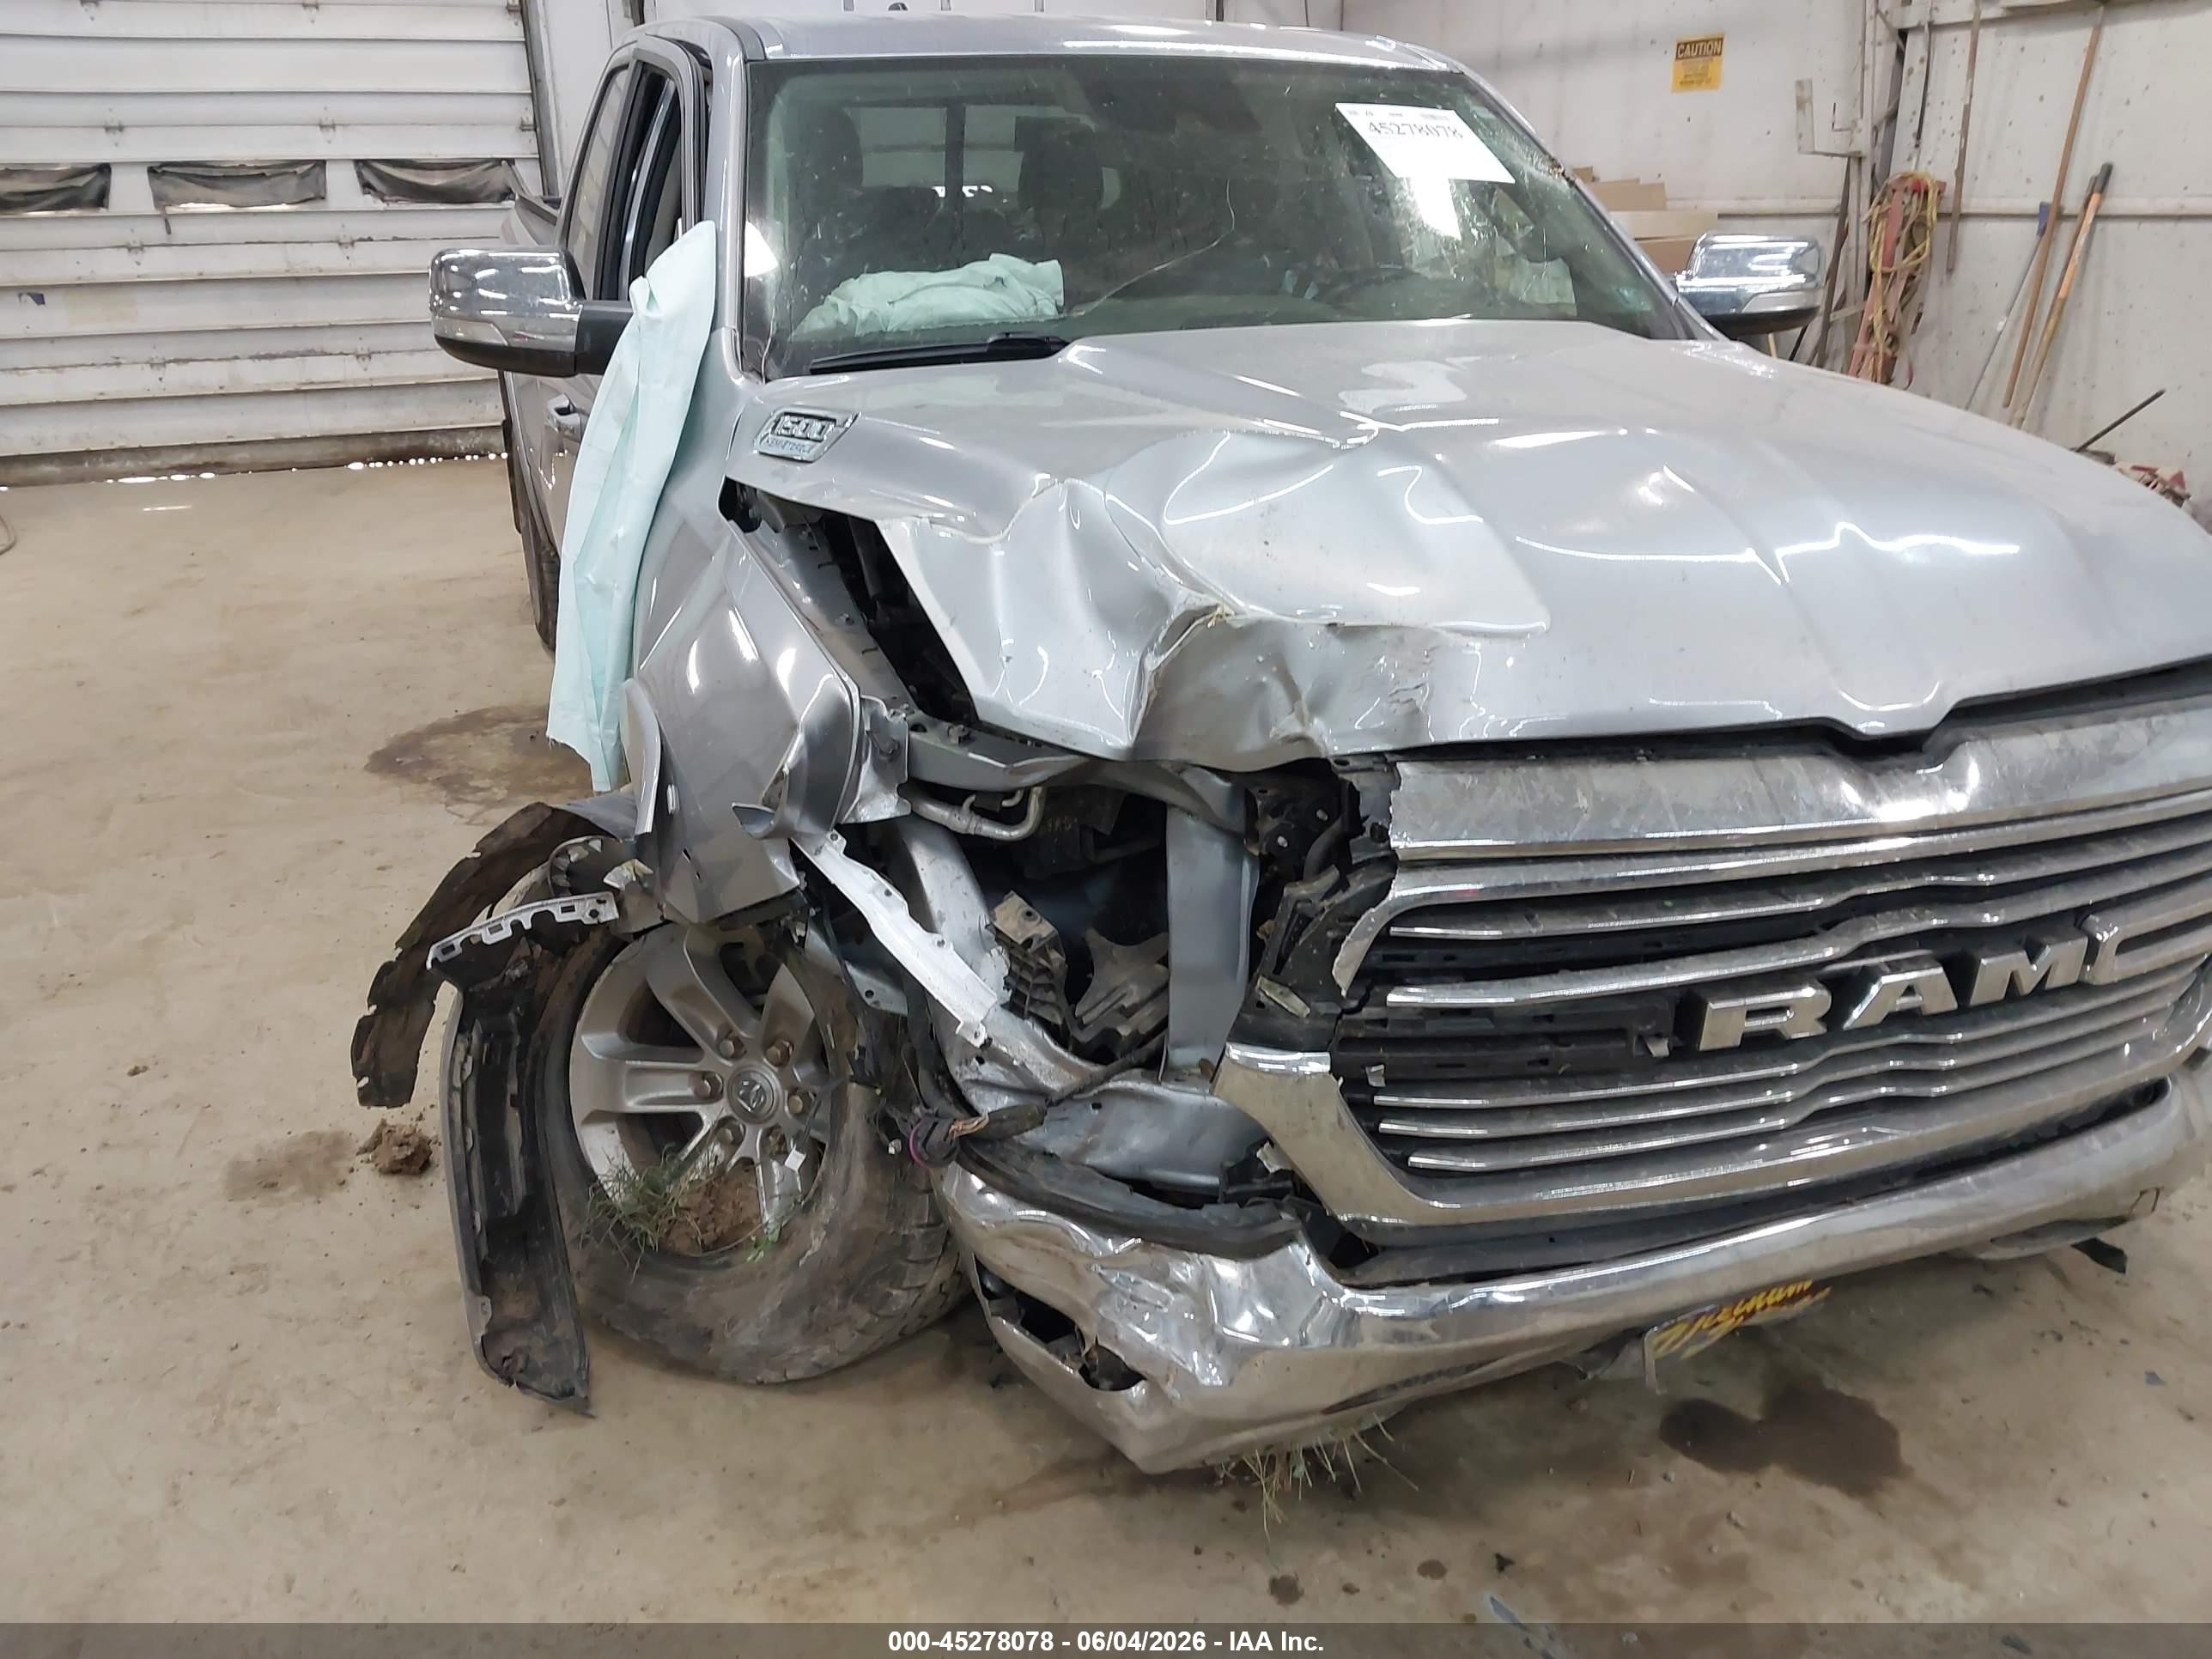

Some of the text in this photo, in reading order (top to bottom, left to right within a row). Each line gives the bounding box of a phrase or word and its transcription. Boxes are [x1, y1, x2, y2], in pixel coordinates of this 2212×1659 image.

[1677, 40, 1722, 58] CAUTION
[1369, 121, 1464, 139] 45278078
[1697, 931, 2088, 1052] RAM
